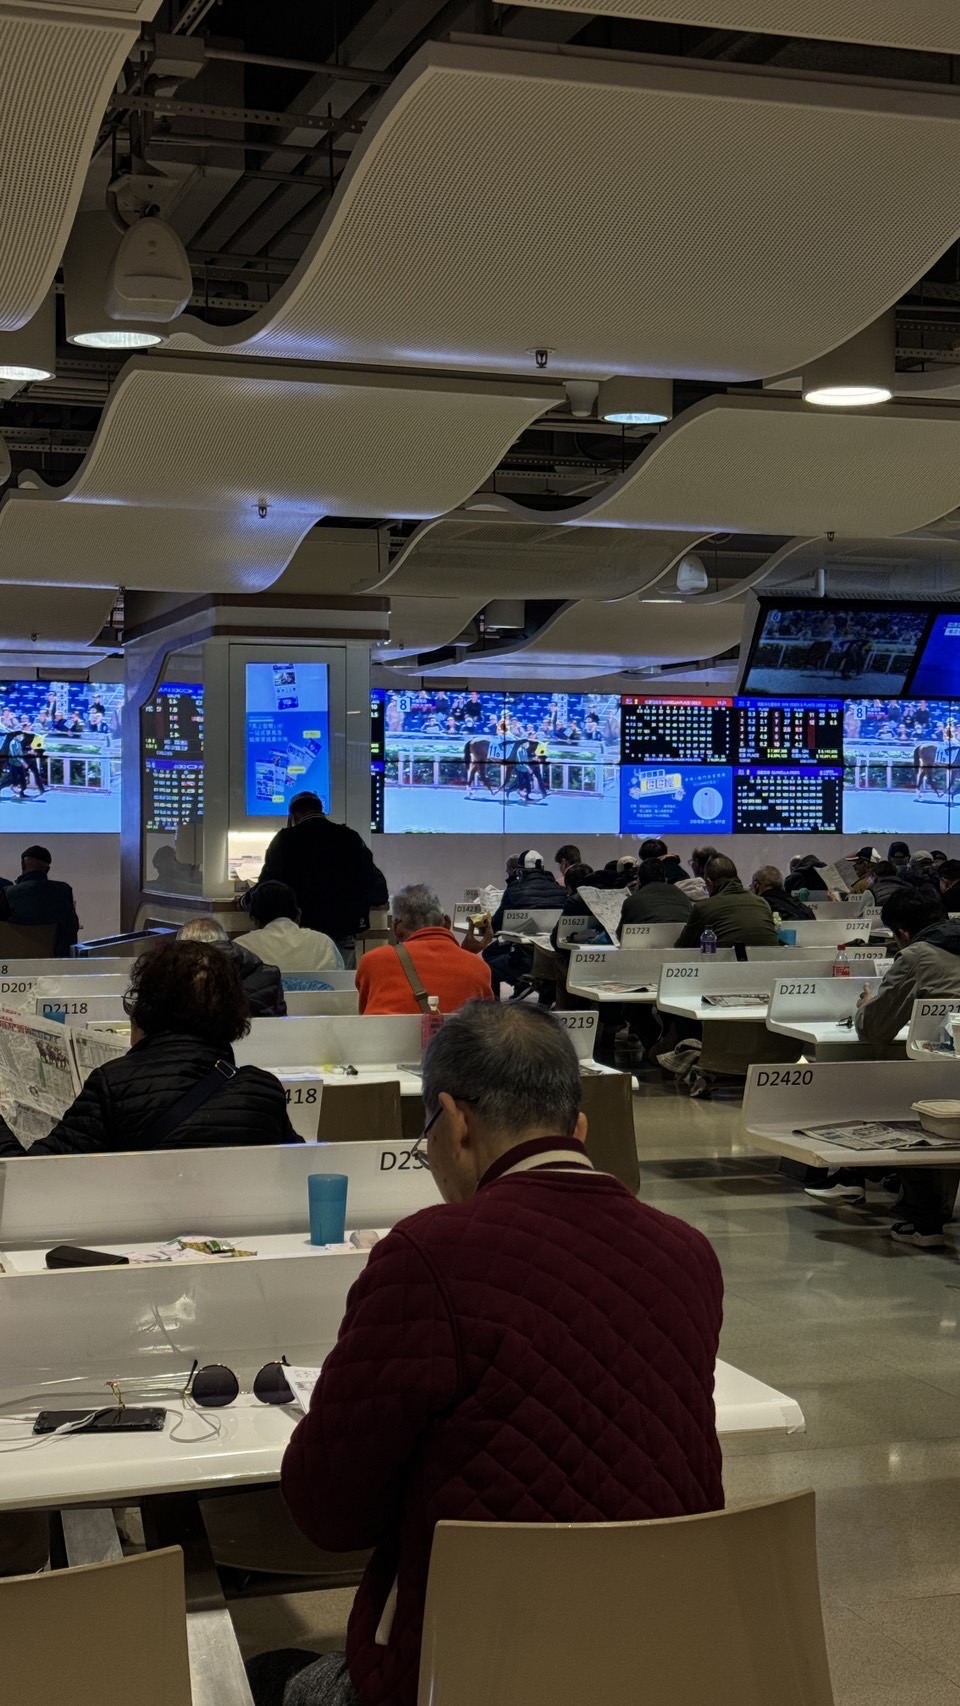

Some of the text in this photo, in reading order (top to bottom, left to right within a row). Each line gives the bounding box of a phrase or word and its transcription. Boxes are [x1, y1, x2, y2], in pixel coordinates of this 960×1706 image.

[400, 699, 407, 710] 8
[856, 707, 863, 718] 8
[506, 912, 529, 920] D1523
[562, 918, 585, 926] D1623
[846, 922, 870, 930] D1724
[625, 926, 650, 935] D1723
[575, 953, 606, 963] D1921
[666, 967, 699, 978] D2021
[1, 982, 38, 993] D201
[780, 983, 816, 995] D2121
[43, 1002, 88, 1015] D2118
[756, 1070, 813, 1087] D2420
